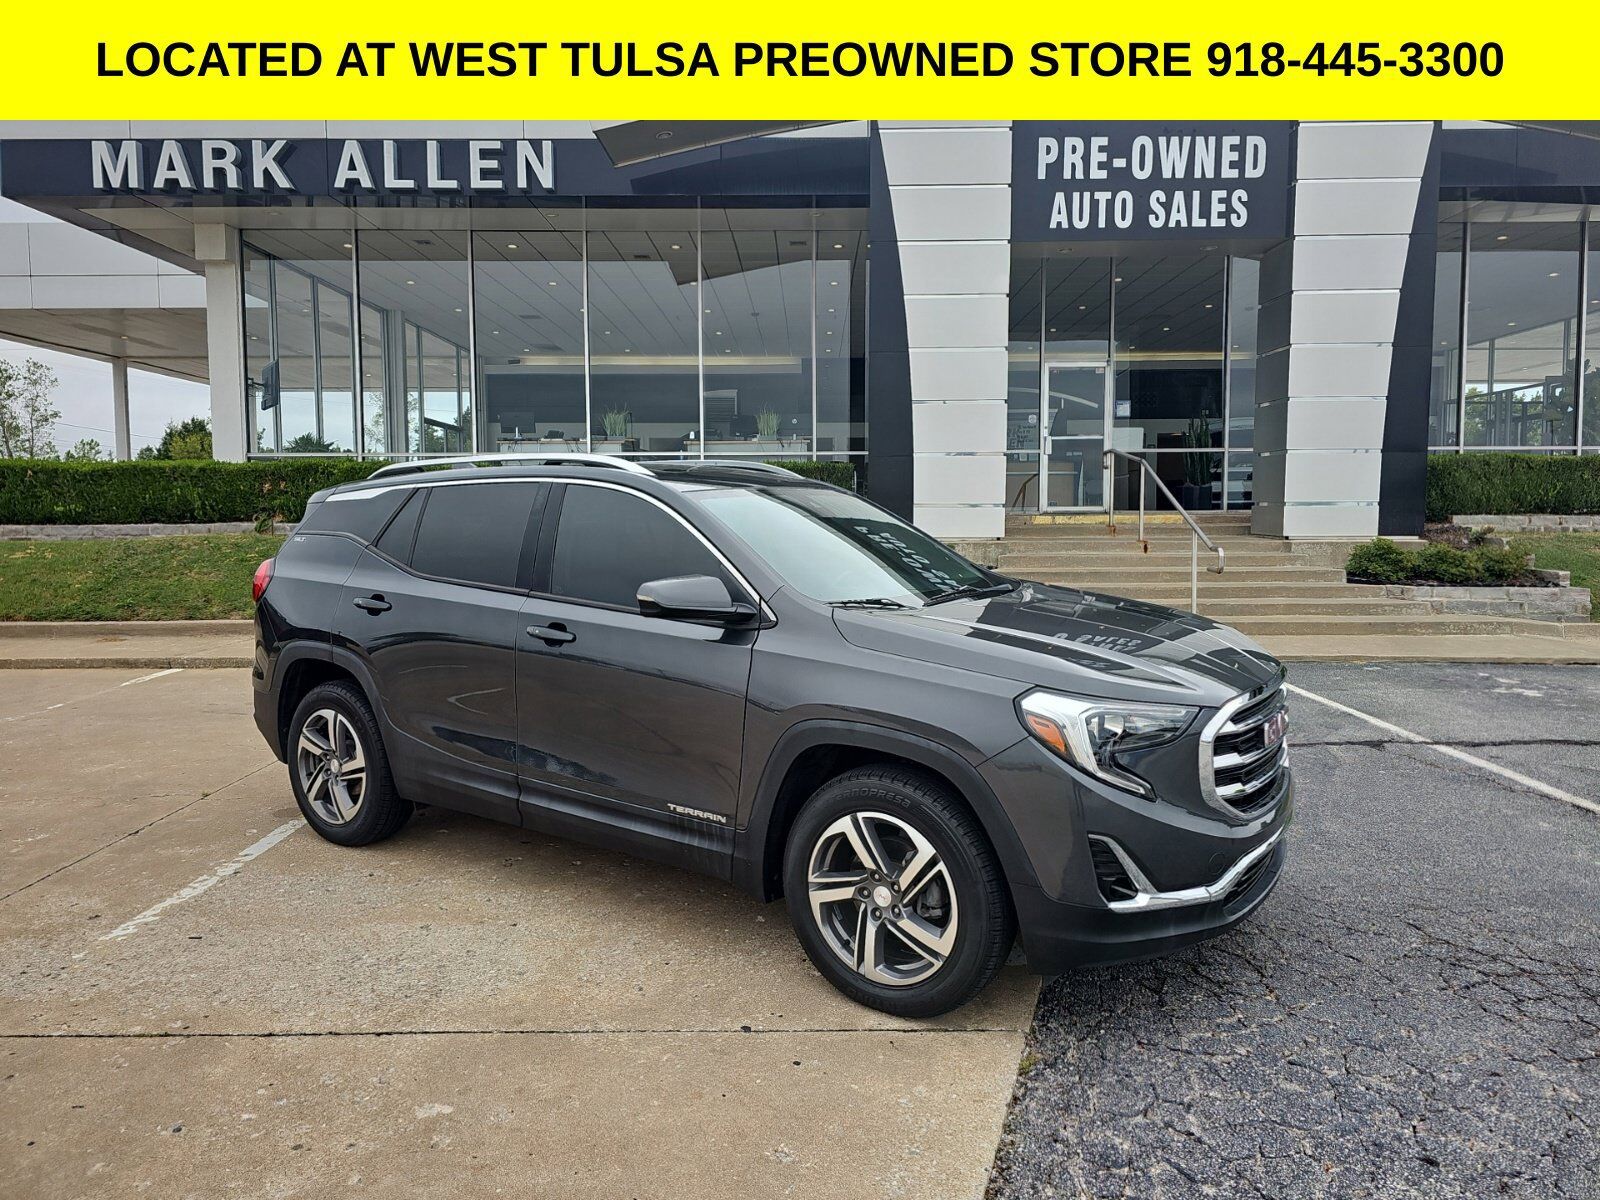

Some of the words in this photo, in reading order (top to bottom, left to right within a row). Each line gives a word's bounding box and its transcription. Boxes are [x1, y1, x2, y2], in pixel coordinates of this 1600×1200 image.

[91, 139, 295, 191] MARK
[333, 139, 555, 191] ALLEN
[1037, 135, 1267, 180] PRE-OWNED
[1049, 190, 1134, 230] AUTO
[1148, 188, 1249, 228] SALES
[667, 803, 727, 823] TERRAIN
